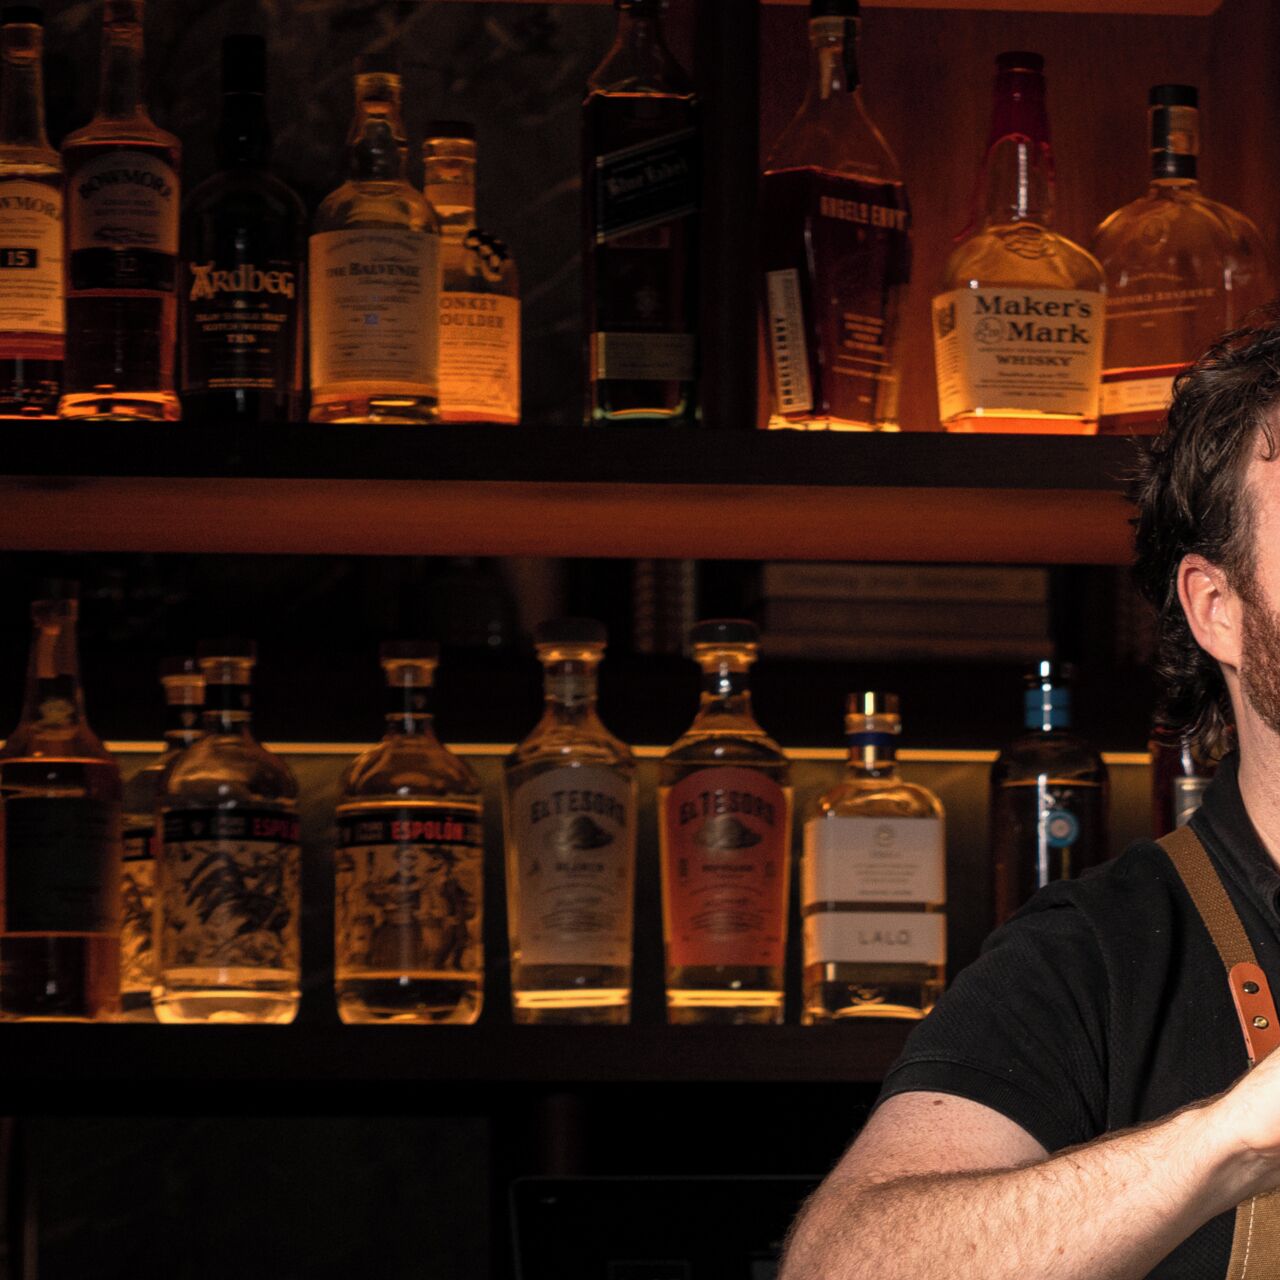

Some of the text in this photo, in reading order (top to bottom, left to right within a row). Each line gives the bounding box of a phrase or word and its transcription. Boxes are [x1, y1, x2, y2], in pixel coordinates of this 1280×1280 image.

[7, 251, 29, 266] 15
[974, 296, 1092, 317] Maker's
[1007, 321, 1090, 345] Mark
[996, 354, 1073, 367] WHISKY
[858, 929, 911, 946] LALO
